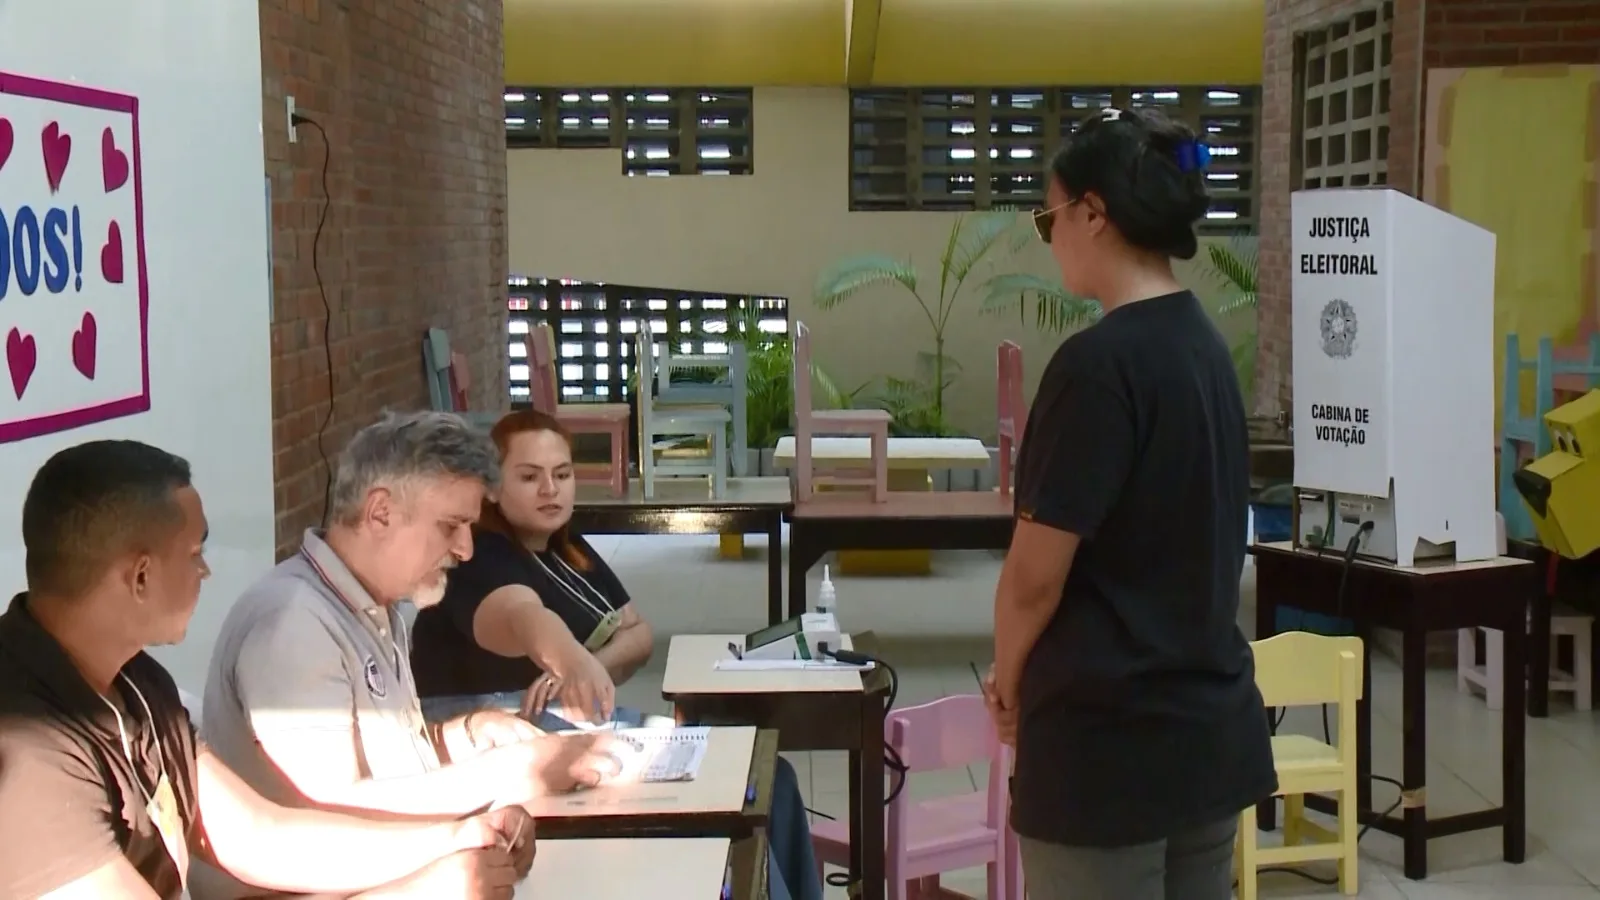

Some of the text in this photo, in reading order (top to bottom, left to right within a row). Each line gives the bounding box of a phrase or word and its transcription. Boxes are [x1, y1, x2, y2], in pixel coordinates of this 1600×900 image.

[1309, 216, 1370, 244] JUSTIÇA
[1300, 253, 1378, 275] ELEITORAL
[1311, 404, 1370, 424] CABINA DE
[1315, 425, 1366, 448] VOTAÇÃO
